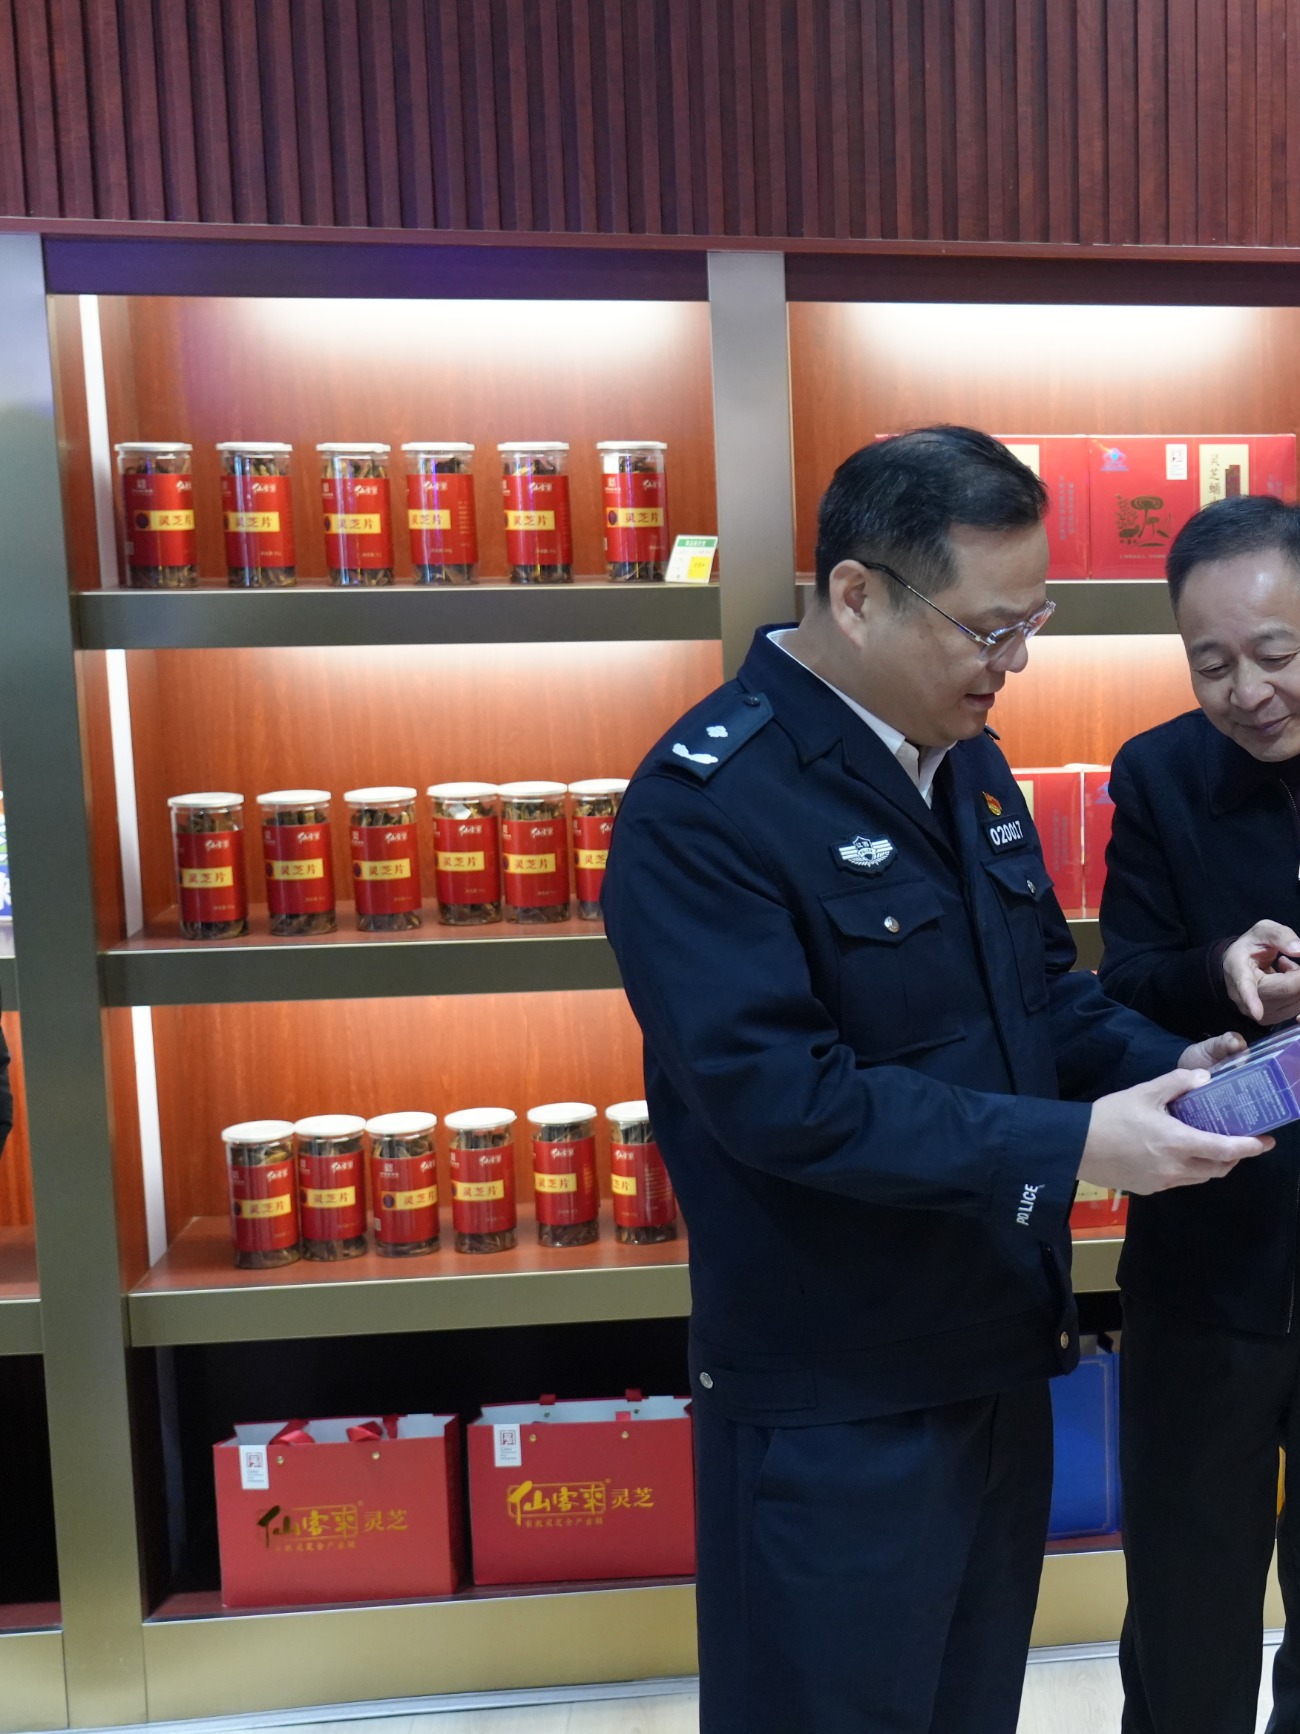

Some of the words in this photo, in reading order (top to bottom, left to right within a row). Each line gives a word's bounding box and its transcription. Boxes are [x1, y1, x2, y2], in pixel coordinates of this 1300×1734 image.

[235, 514, 272, 527] 灵芝片
[336, 515, 374, 530] 灵芝片
[513, 514, 548, 526] 灵芝片
[625, 511, 659, 524] 灵芝片
[989, 820, 1024, 846] 020017
[442, 856, 477, 867] 灵芝片
[514, 858, 550, 870] 灵芝片
[585, 855, 608, 865] 灵芝
[280, 863, 317, 877] 灵芝片
[368, 863, 405, 877] 灵芝片
[188, 871, 226, 885] 灵芝片
[538, 1177, 569, 1189] 灵芝片
[611, 1179, 630, 1192] 芝片
[313, 1192, 349, 1204] 灵芝片
[404, 1191, 435, 1205] 灵芝片
[463, 1185, 497, 1198] 灵芝片
[250, 1202, 285, 1215] 灵芝片
[1016, 1183, 1039, 1226] POLICE
[611, 1487, 654, 1509] 灵芝
[363, 1509, 408, 1532] 灵芝
